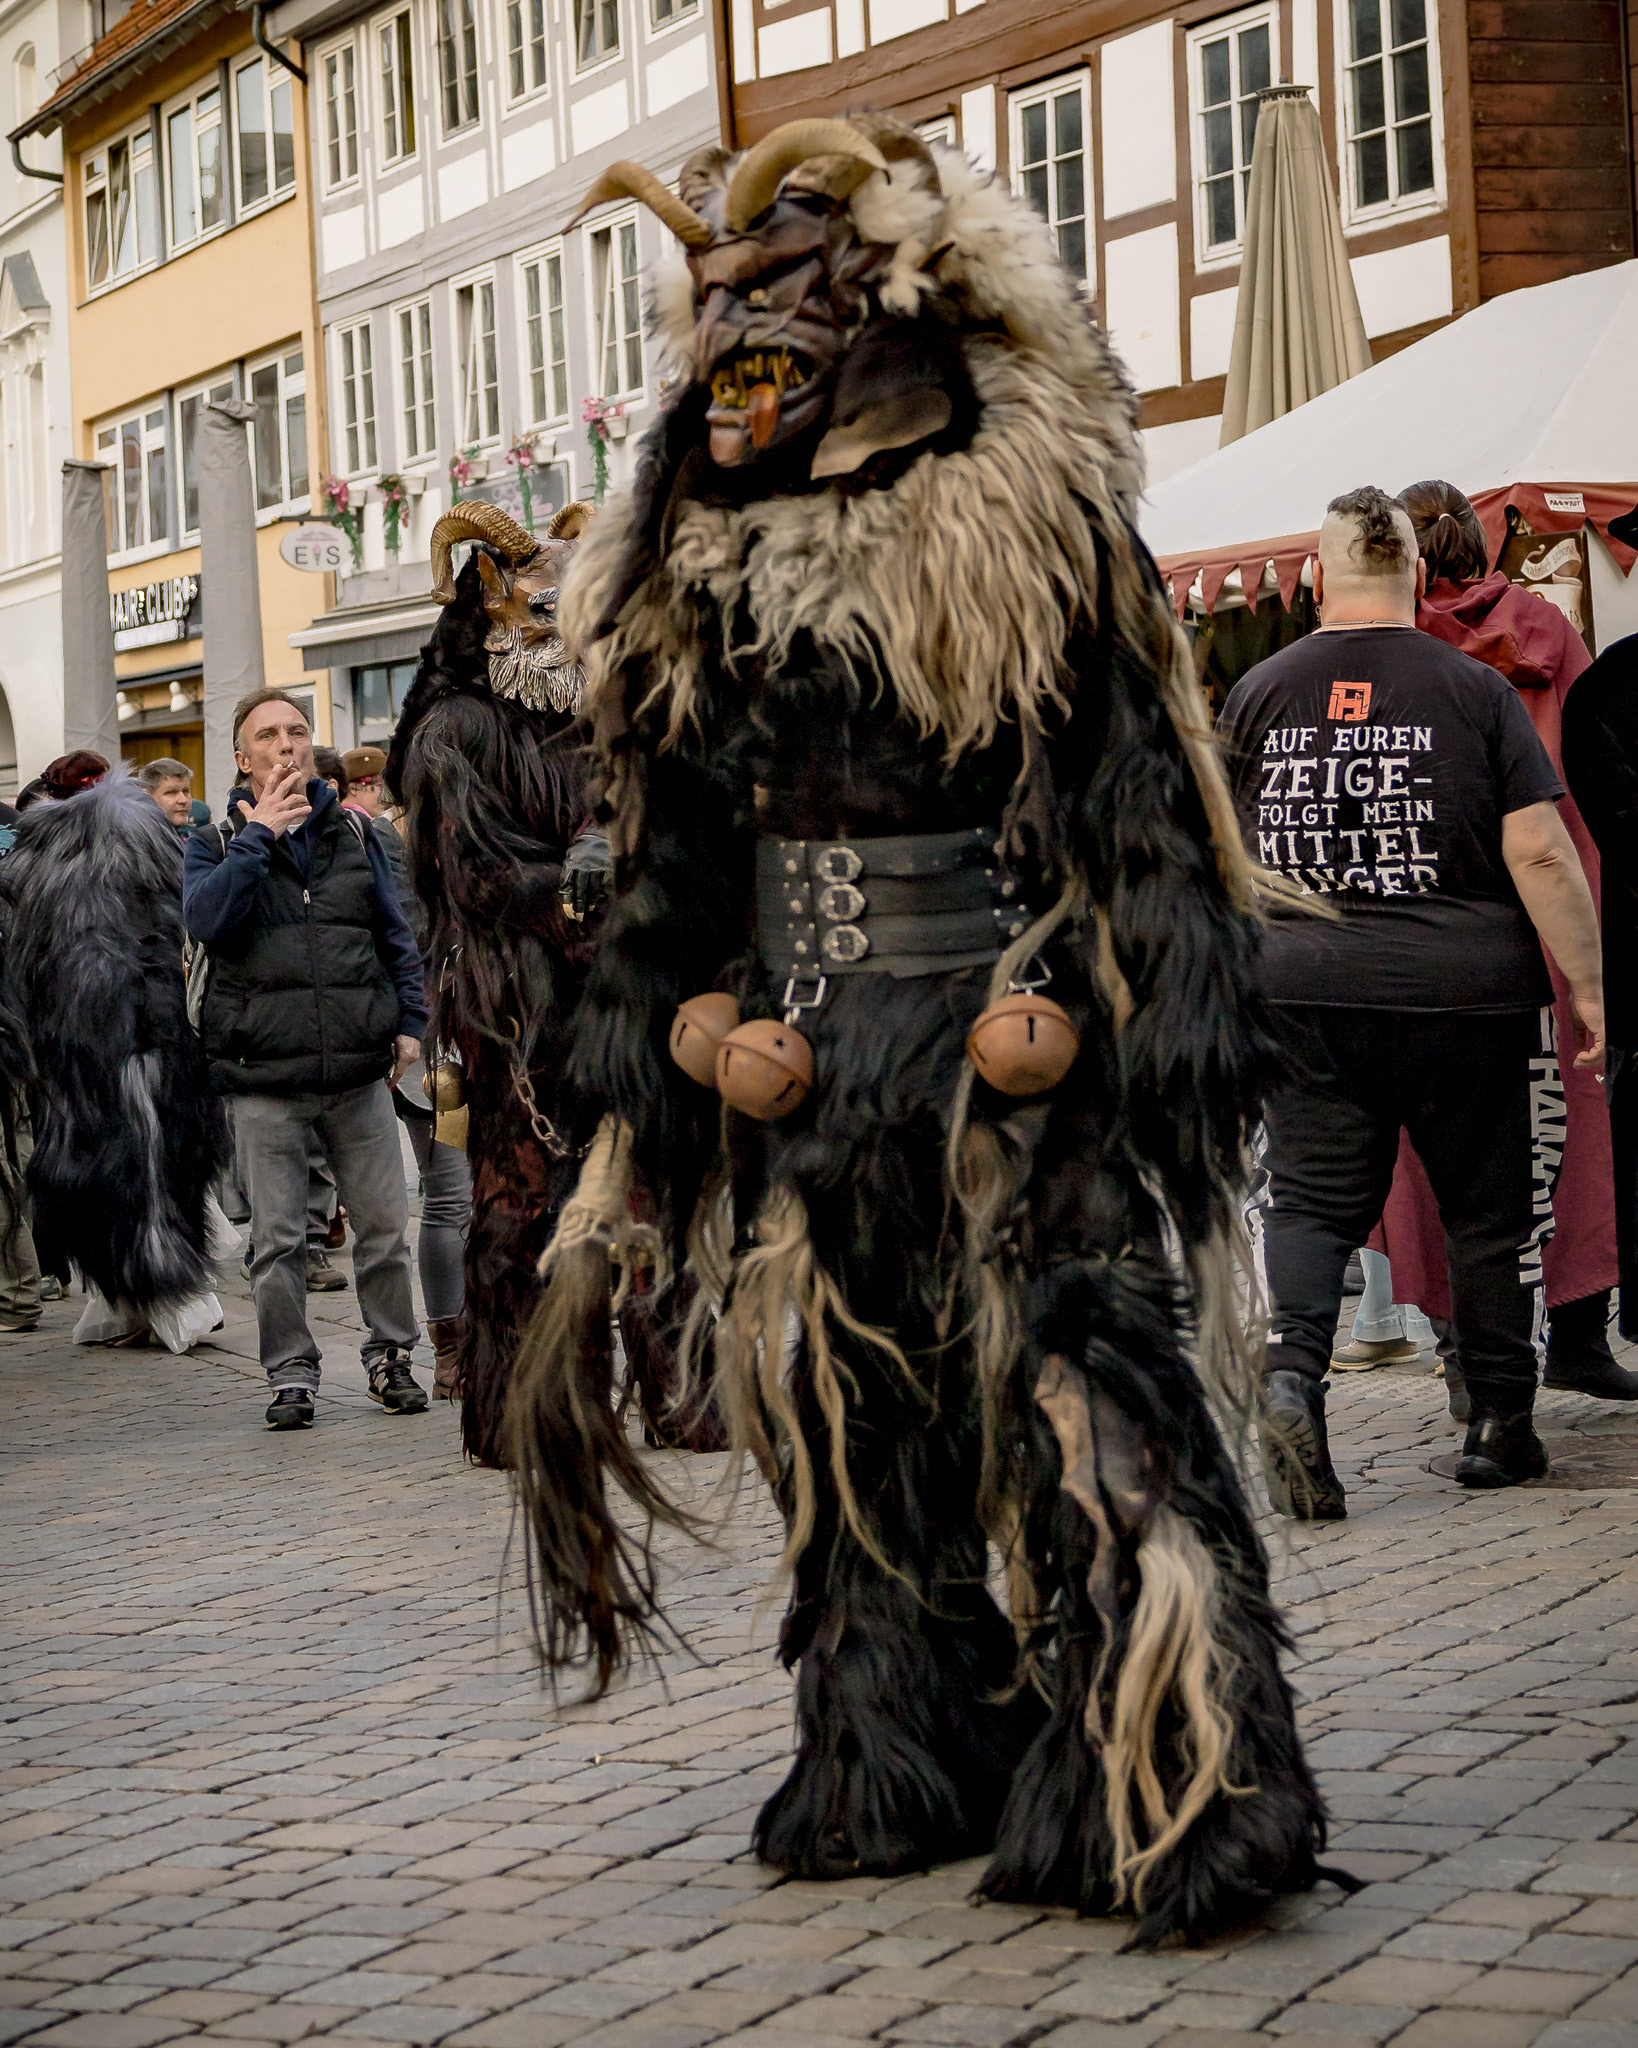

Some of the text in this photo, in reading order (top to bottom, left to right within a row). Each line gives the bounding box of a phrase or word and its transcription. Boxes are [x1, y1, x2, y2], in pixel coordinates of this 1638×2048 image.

[146, 577, 183, 624] CLUB
[1263, 726, 1433, 754] AUF EUREN
[1261, 756, 1433, 800] ZEIGE-
[1258, 800, 1436, 827] FOLGT MEIN
[1257, 827, 1439, 866] MITTEL
